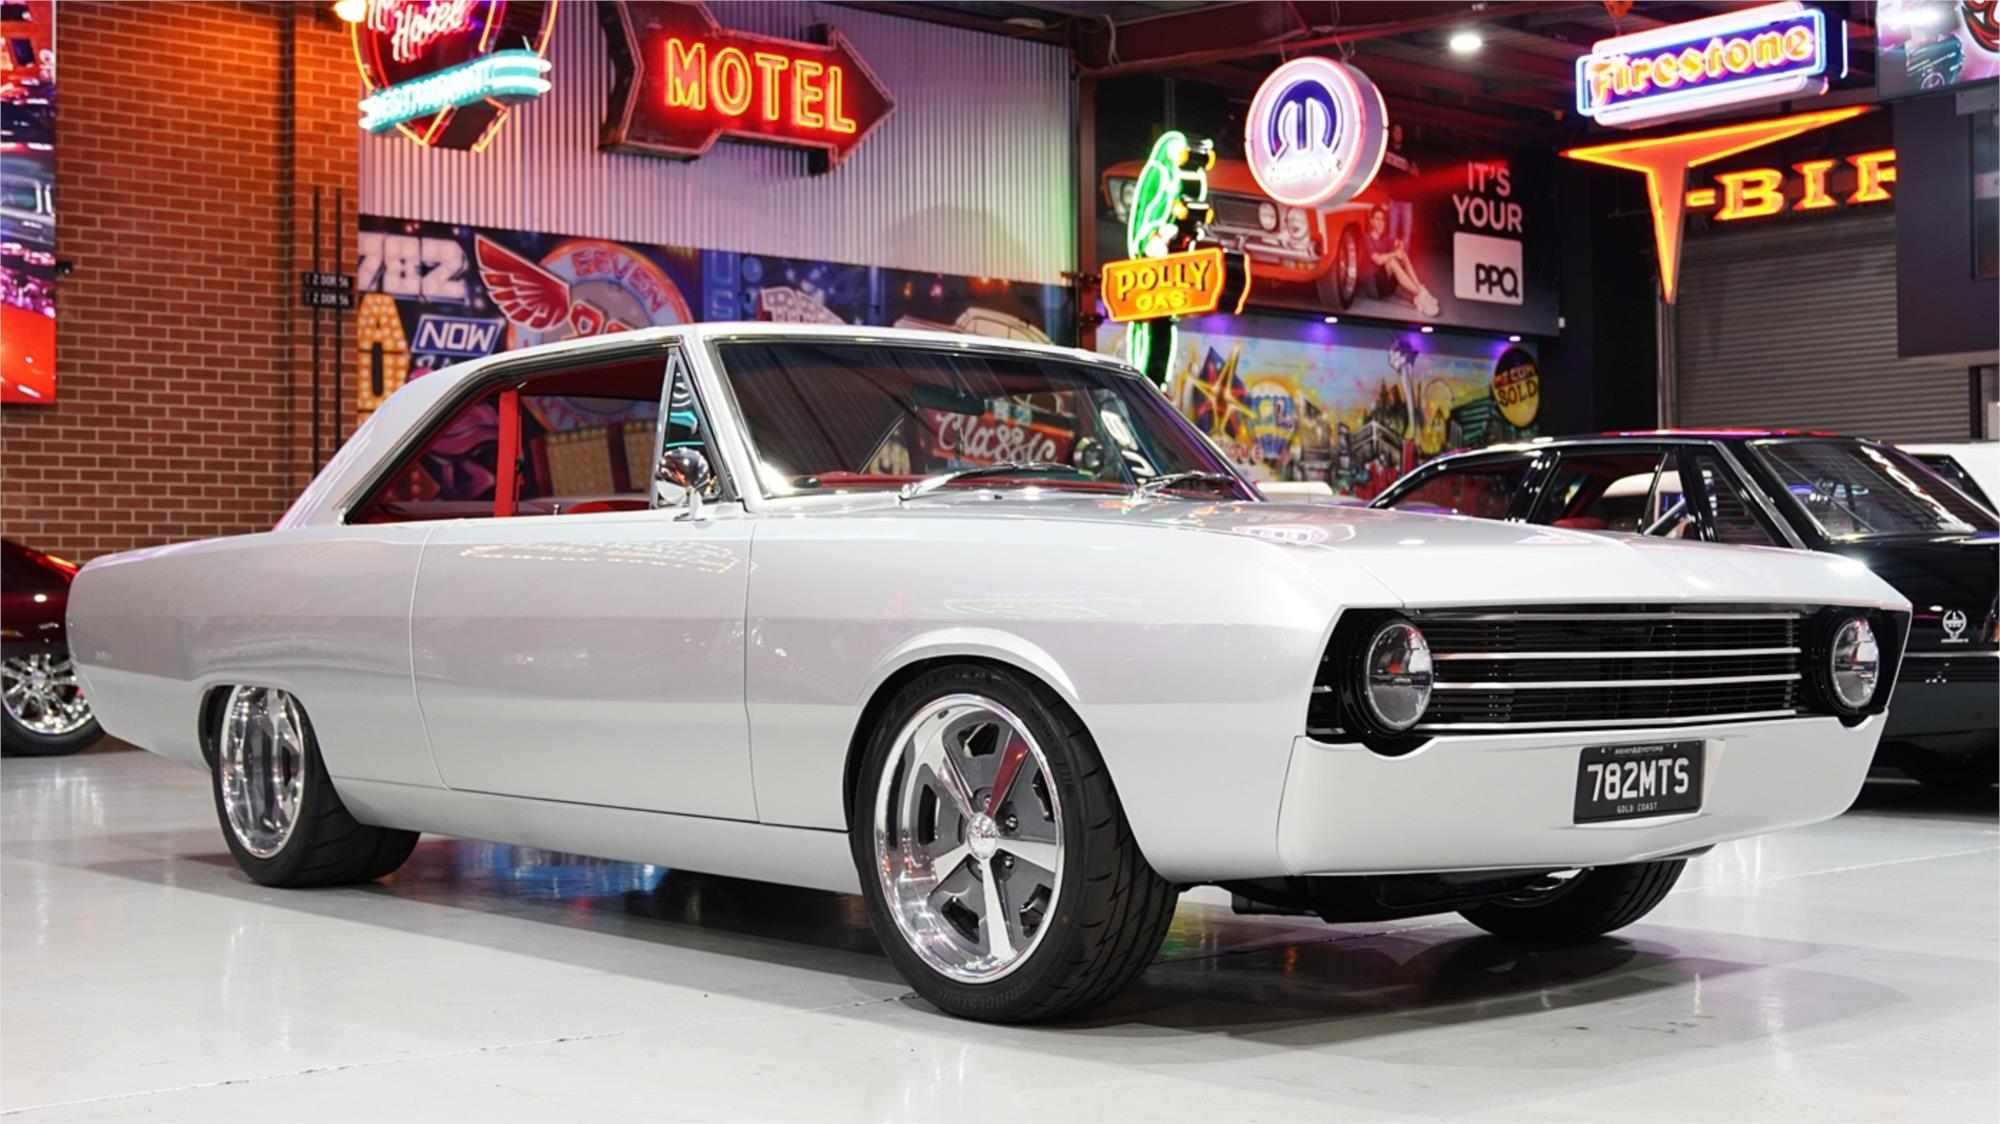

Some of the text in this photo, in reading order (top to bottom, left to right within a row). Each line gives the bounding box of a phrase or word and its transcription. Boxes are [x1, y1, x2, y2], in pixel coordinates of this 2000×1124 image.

[391, 2, 470, 62] Hotel
[667, 38, 857, 134] MOTEL
[1590, 26, 1814, 106] Firestone
[1468, 161, 1511, 197] IT'S
[1452, 193, 1523, 233] YOUR
[359, 233, 469, 300] 782
[571, 249, 669, 313] SEVEN
[1115, 259, 1212, 301] POLLY
[1475, 263, 1519, 298] PPQ
[1135, 289, 1188, 312] GAS
[419, 322, 494, 352] NOW
[1497, 380, 1538, 407] SOLD
[1587, 757, 1690, 802] 782MTS
[1617, 802, 1658, 814] GOLD COAST
